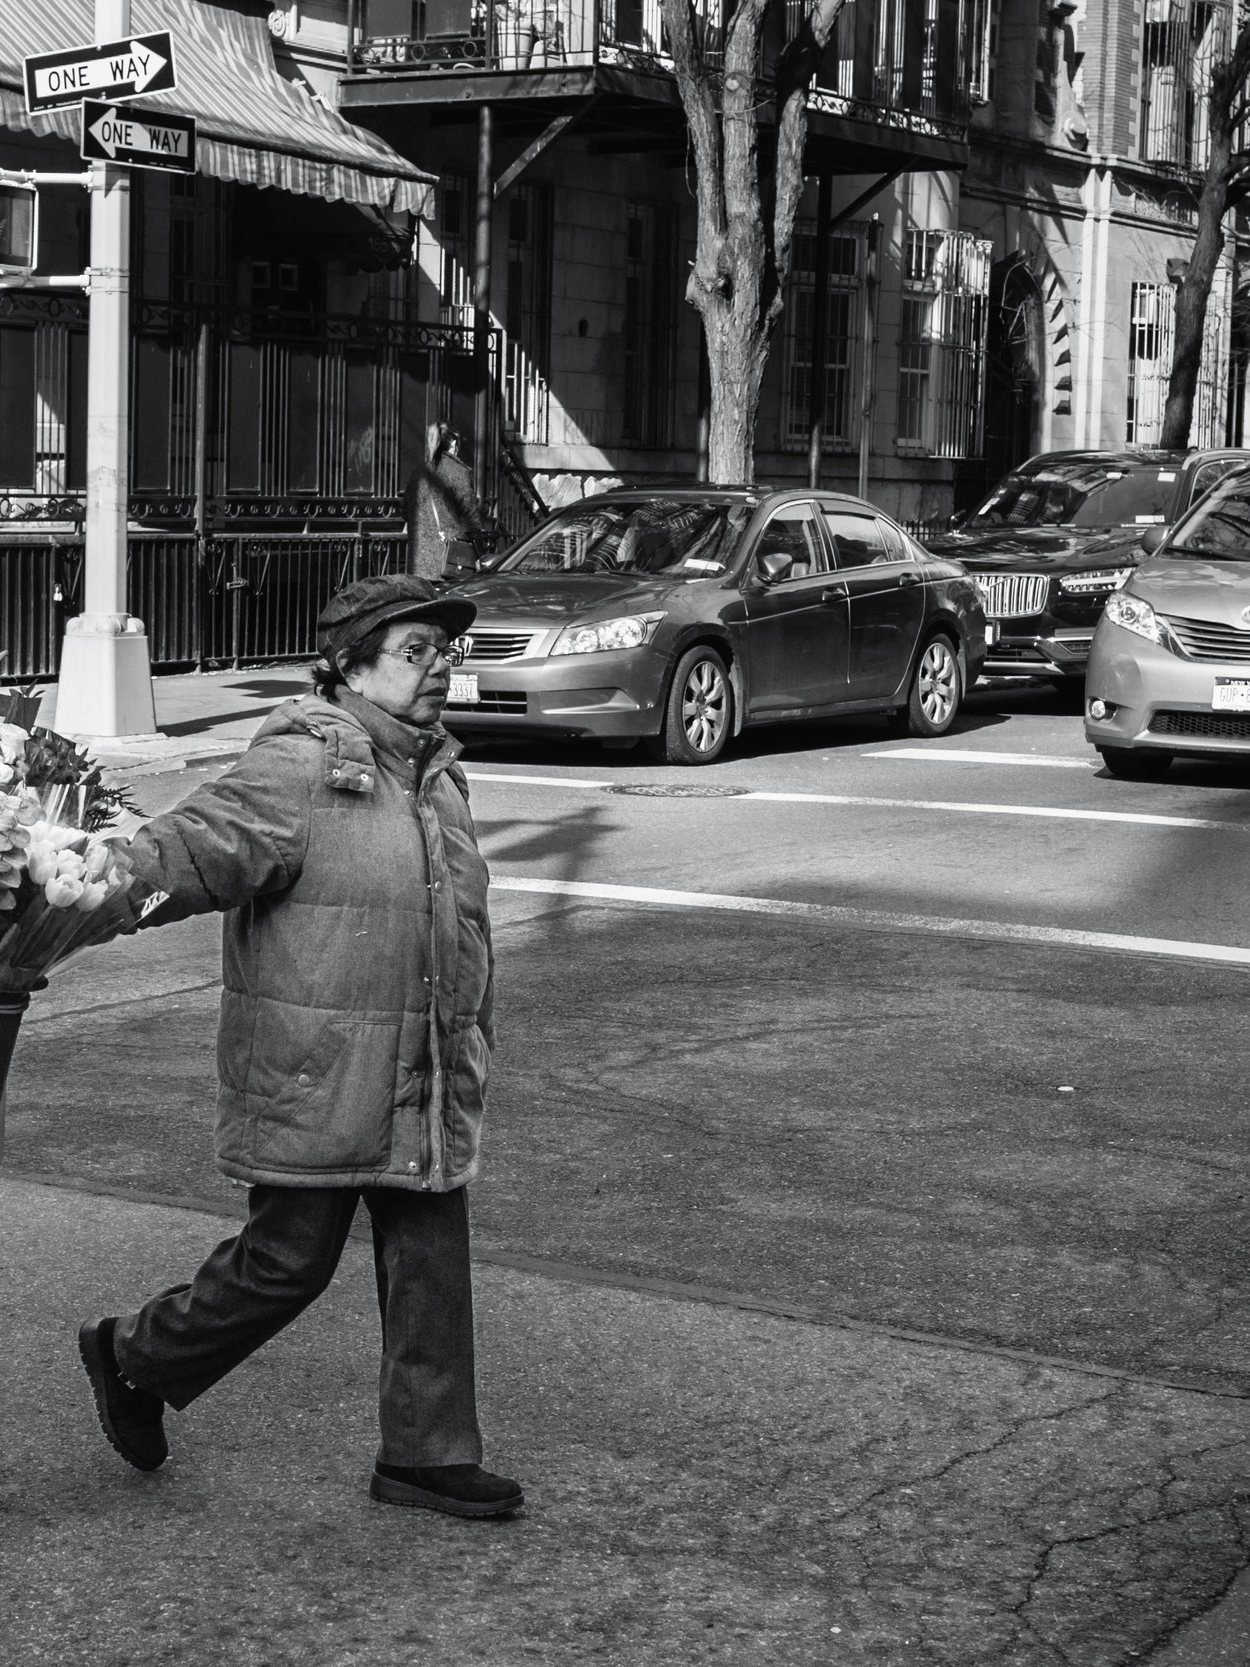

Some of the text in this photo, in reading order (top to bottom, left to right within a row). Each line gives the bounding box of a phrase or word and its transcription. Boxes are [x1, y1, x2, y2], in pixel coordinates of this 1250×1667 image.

[48, 54, 151, 92] ONE WAY
[101, 121, 182, 153] ONE WAY
